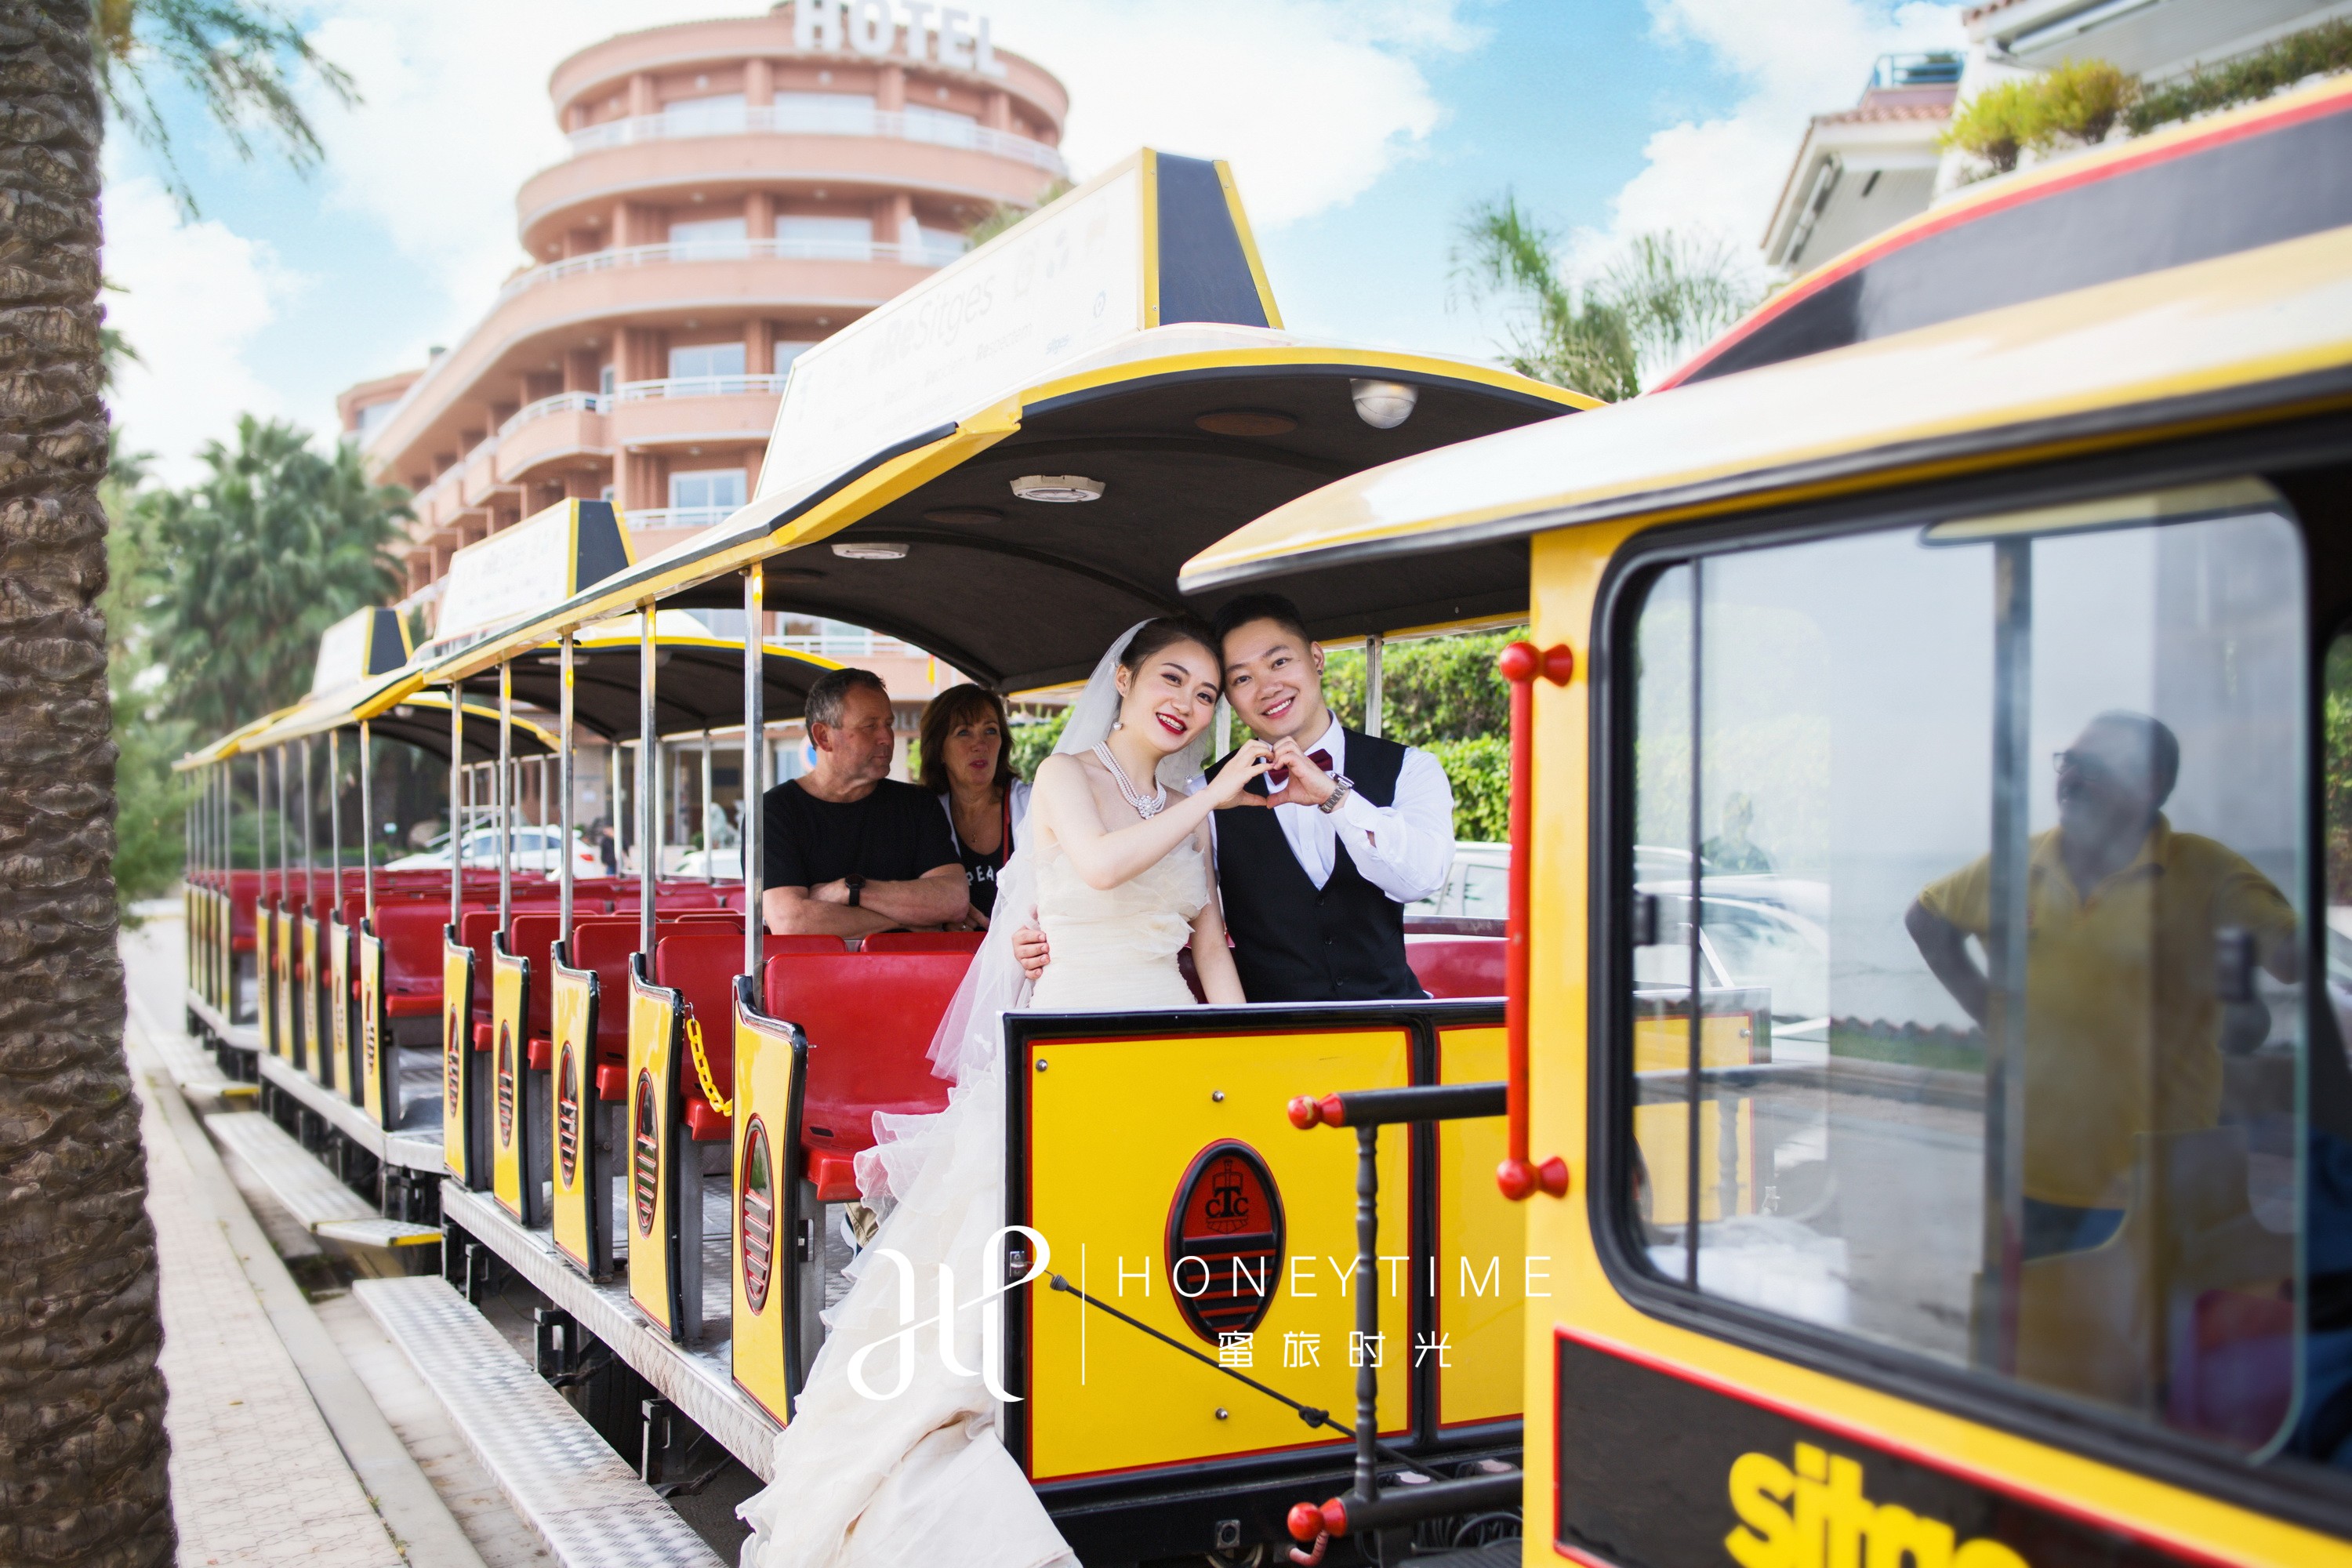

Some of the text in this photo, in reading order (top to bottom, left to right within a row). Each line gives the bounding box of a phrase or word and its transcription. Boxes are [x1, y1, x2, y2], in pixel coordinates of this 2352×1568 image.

[793, 0, 1007, 78] HOTEL
[966, 865, 995, 887] PEA
[1725, 1441, 2032, 1568] sit
